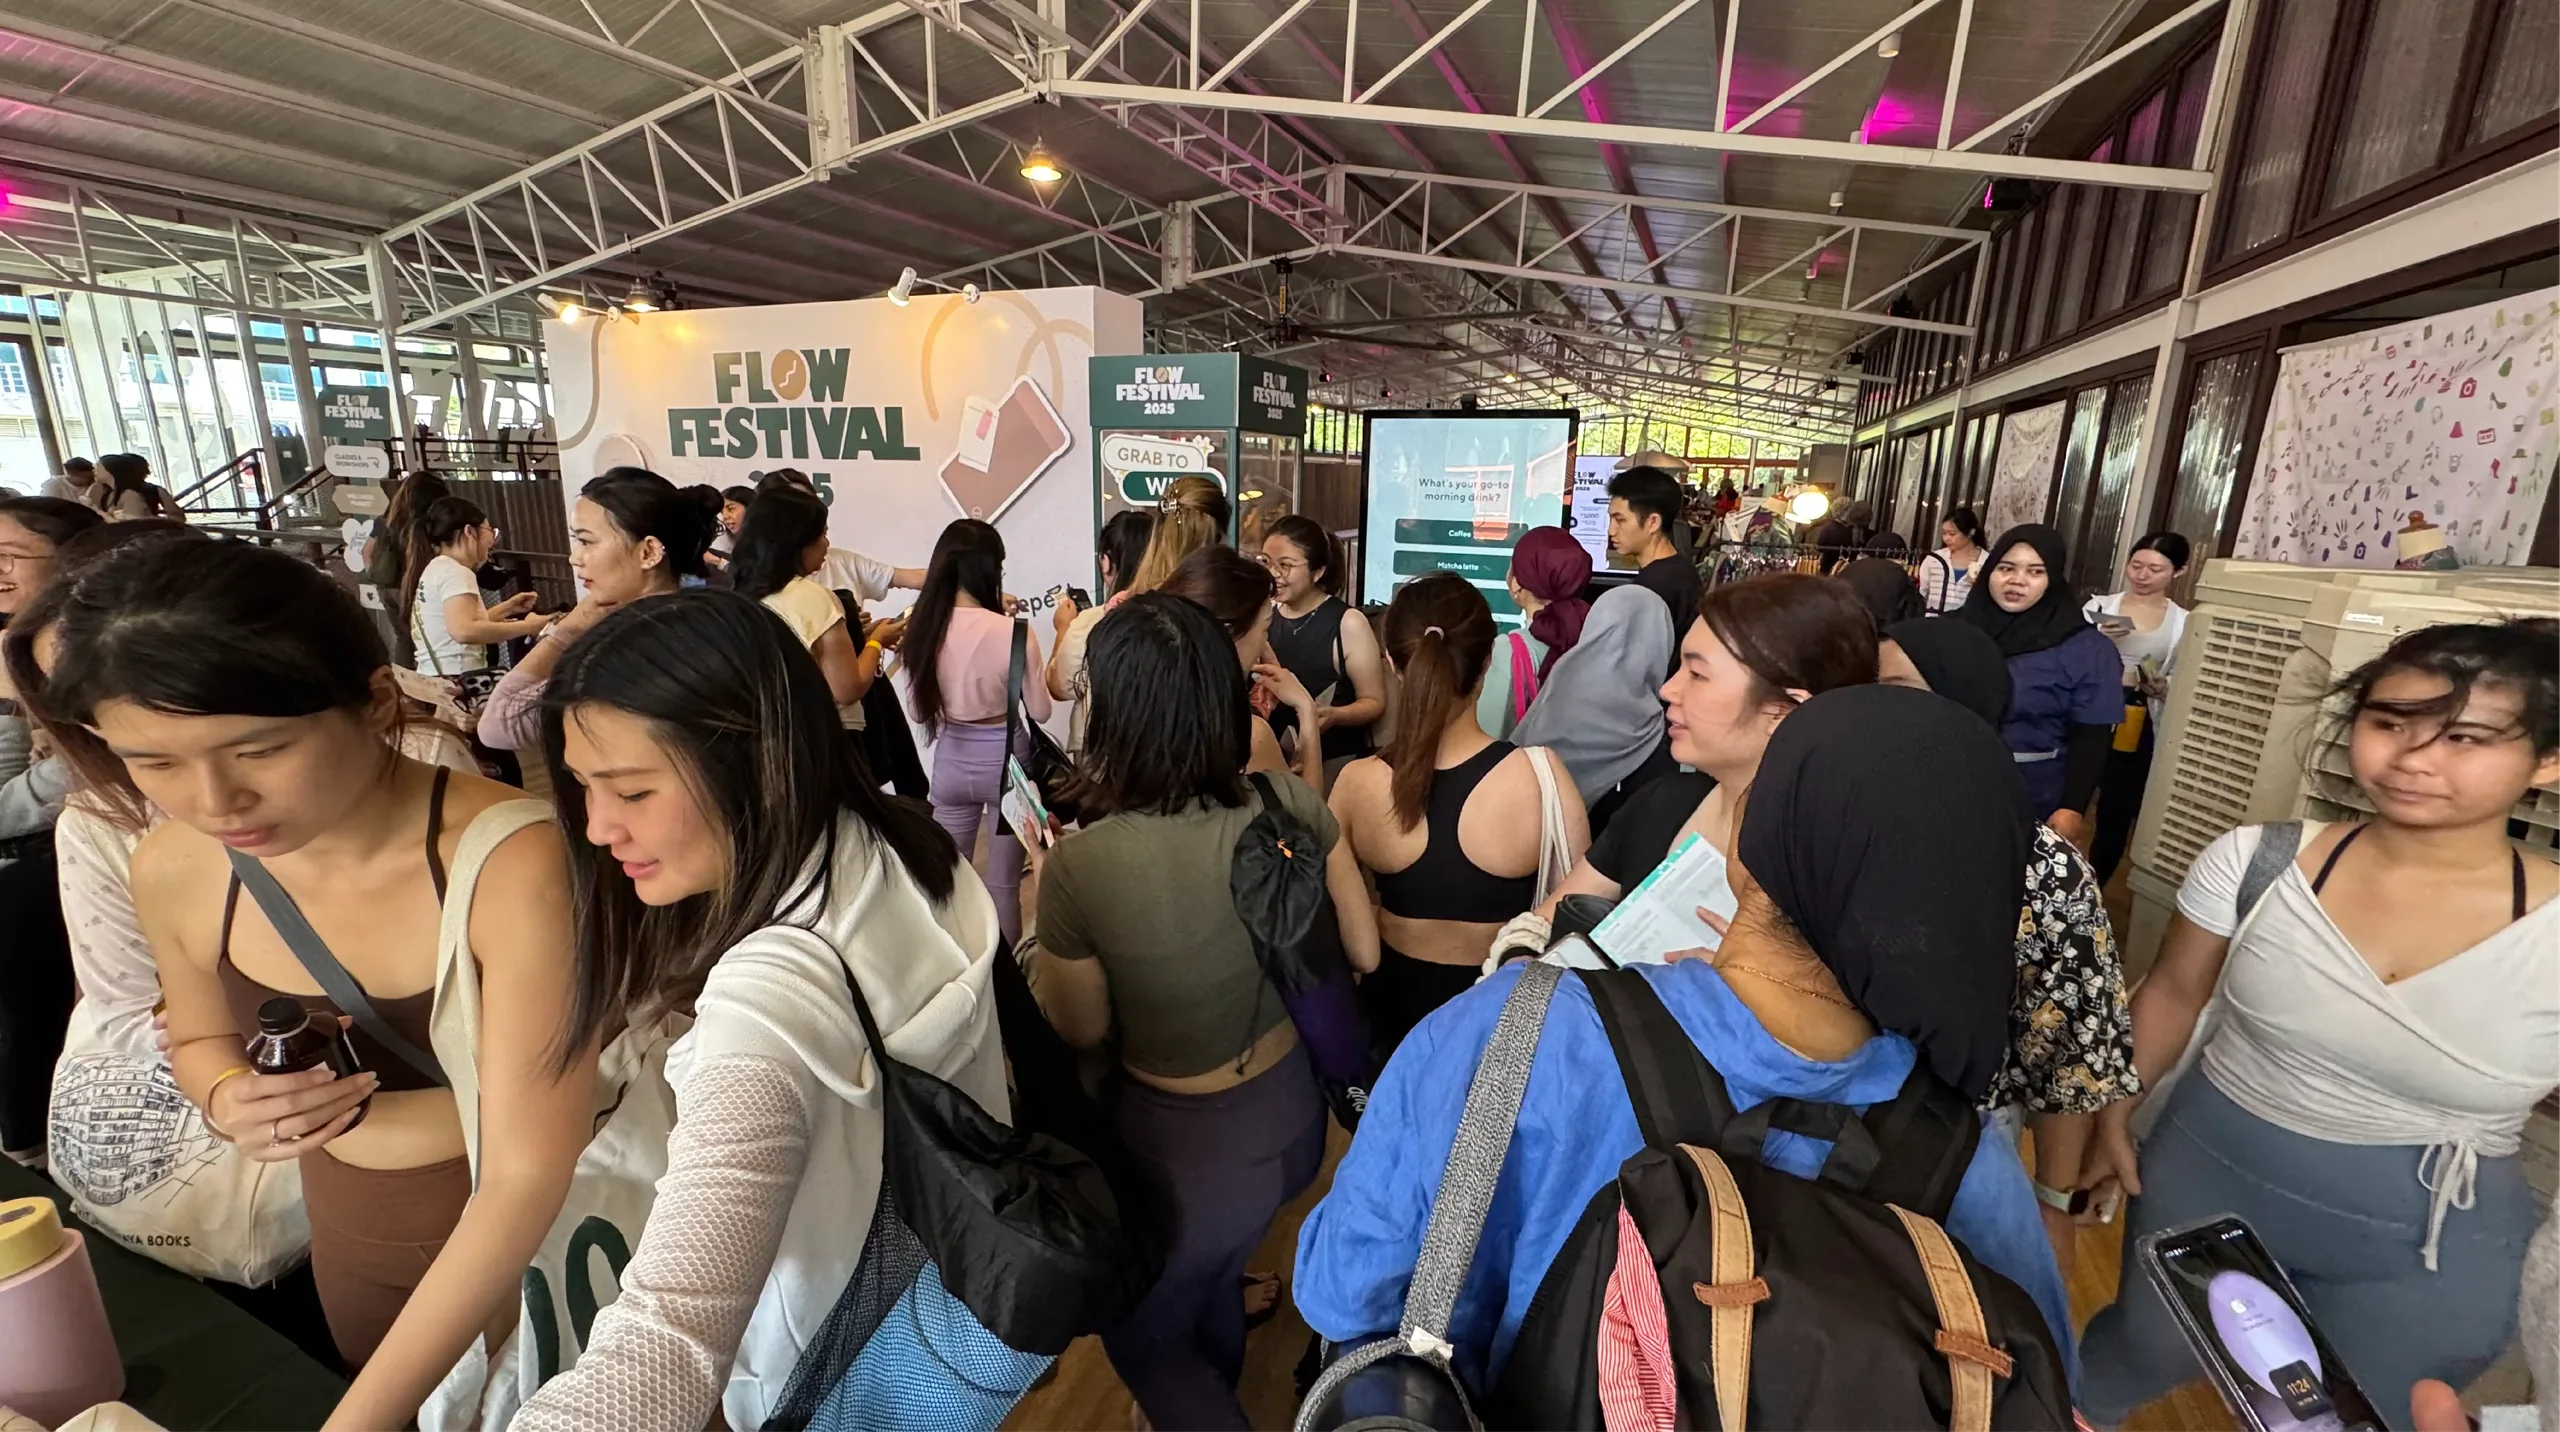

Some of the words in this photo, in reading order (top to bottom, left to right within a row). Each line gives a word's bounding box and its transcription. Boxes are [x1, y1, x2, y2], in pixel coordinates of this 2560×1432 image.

[713, 348, 851, 404] FLOW
[1135, 366, 1184, 384] FLOW
[1263, 371, 1288, 391] FLOW
[1115, 383, 1205, 401] FESTIVAL
[1252, 385, 1296, 409] FESTIVAL
[337, 394, 369, 407] FLOW
[324, 405, 384, 420] FESTIVAL
[1143, 402, 1176, 415] 2025
[1266, 406, 1284, 421] 2025
[344, 419, 366, 429] 2025
[667, 406, 921, 461] FESTIVAL
[1117, 447, 1163, 466] GRAB
[1166, 453, 1189, 469] TO
[1419, 478, 1454, 488] What's
[1455, 480, 1478, 491] your
[1480, 480, 1510, 491] go-to
[1424, 492, 1466, 504] morning
[1448, 529, 1472, 538] Coffee
[1437, 561, 1463, 570] Matcha
[1463, 562, 1480, 571] latte
[147, 1235, 192, 1248] BOOKS
